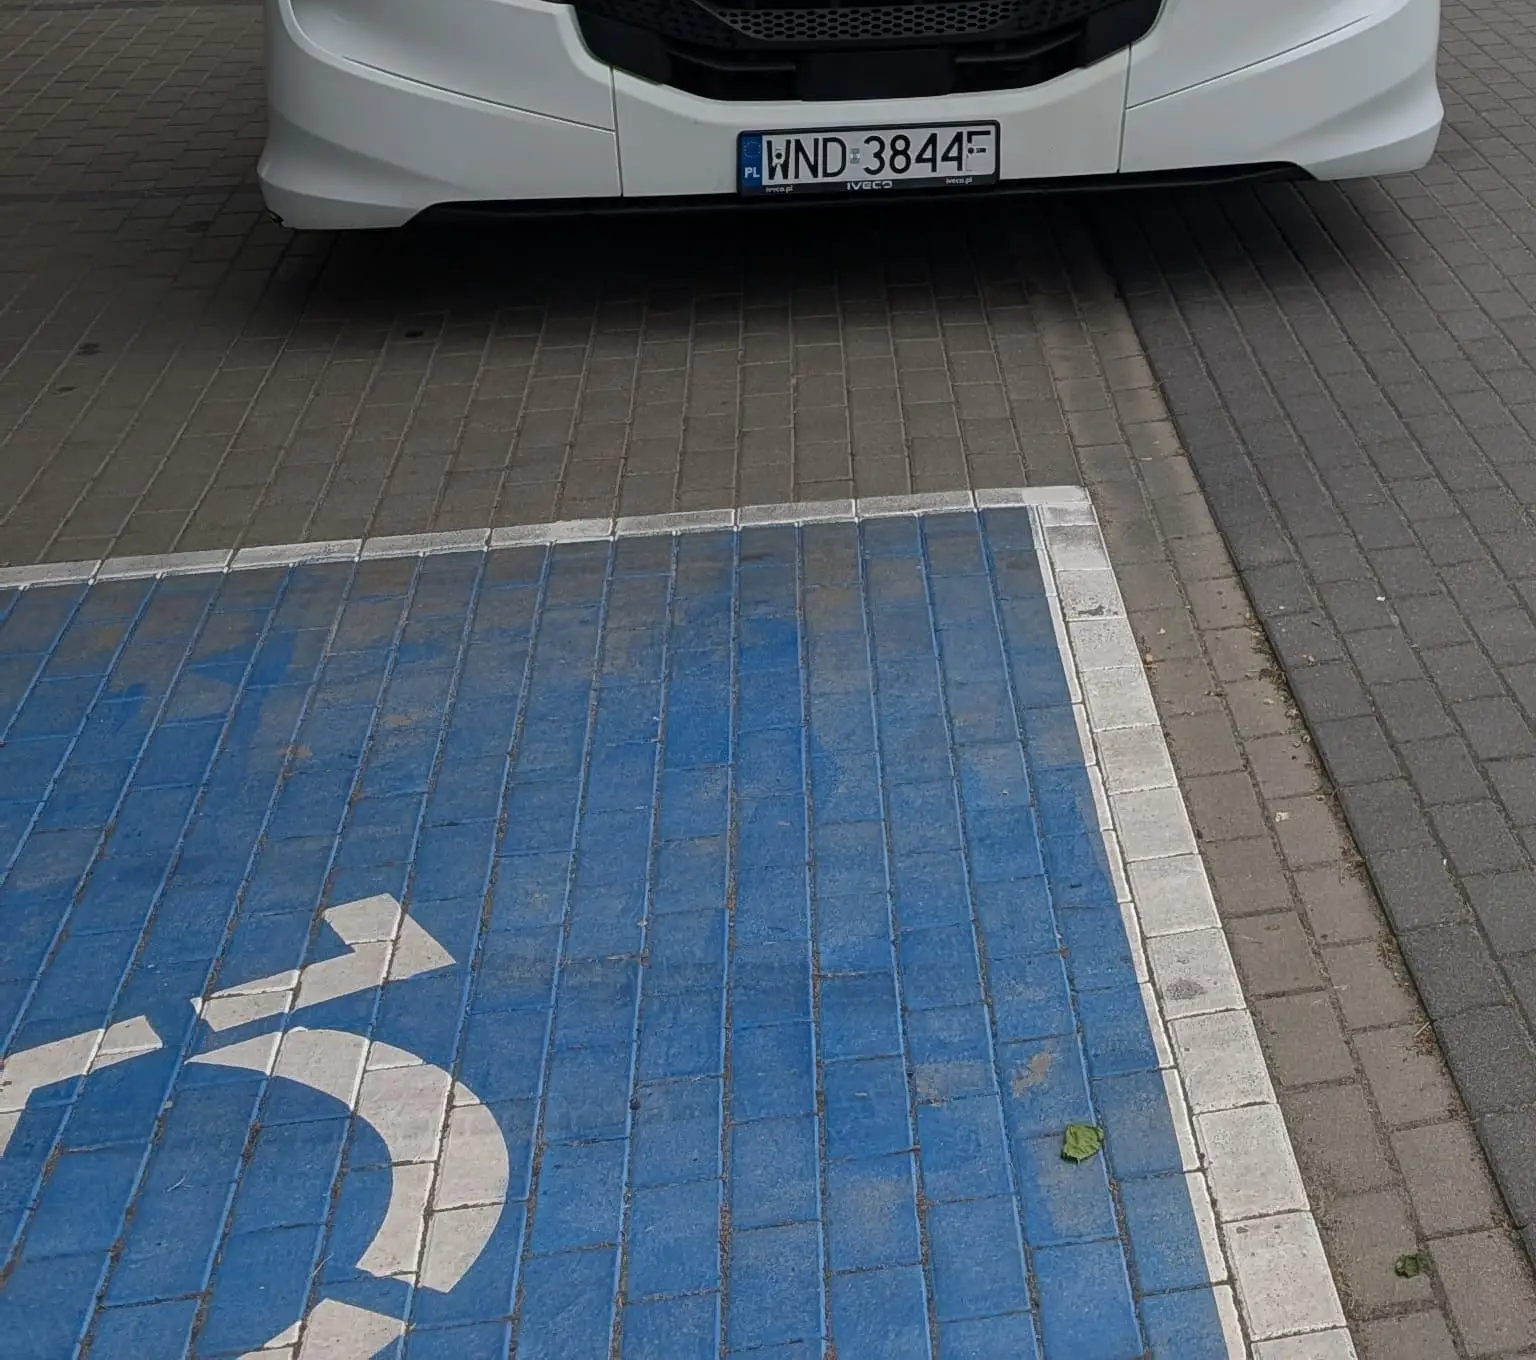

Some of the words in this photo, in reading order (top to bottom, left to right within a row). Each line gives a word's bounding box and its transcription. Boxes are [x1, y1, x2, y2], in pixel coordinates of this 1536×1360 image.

[766, 137, 847, 181] WND
[862, 130, 992, 176] 3844F
[744, 167, 761, 179] PL
[846, 180, 893, 191] IVECO
